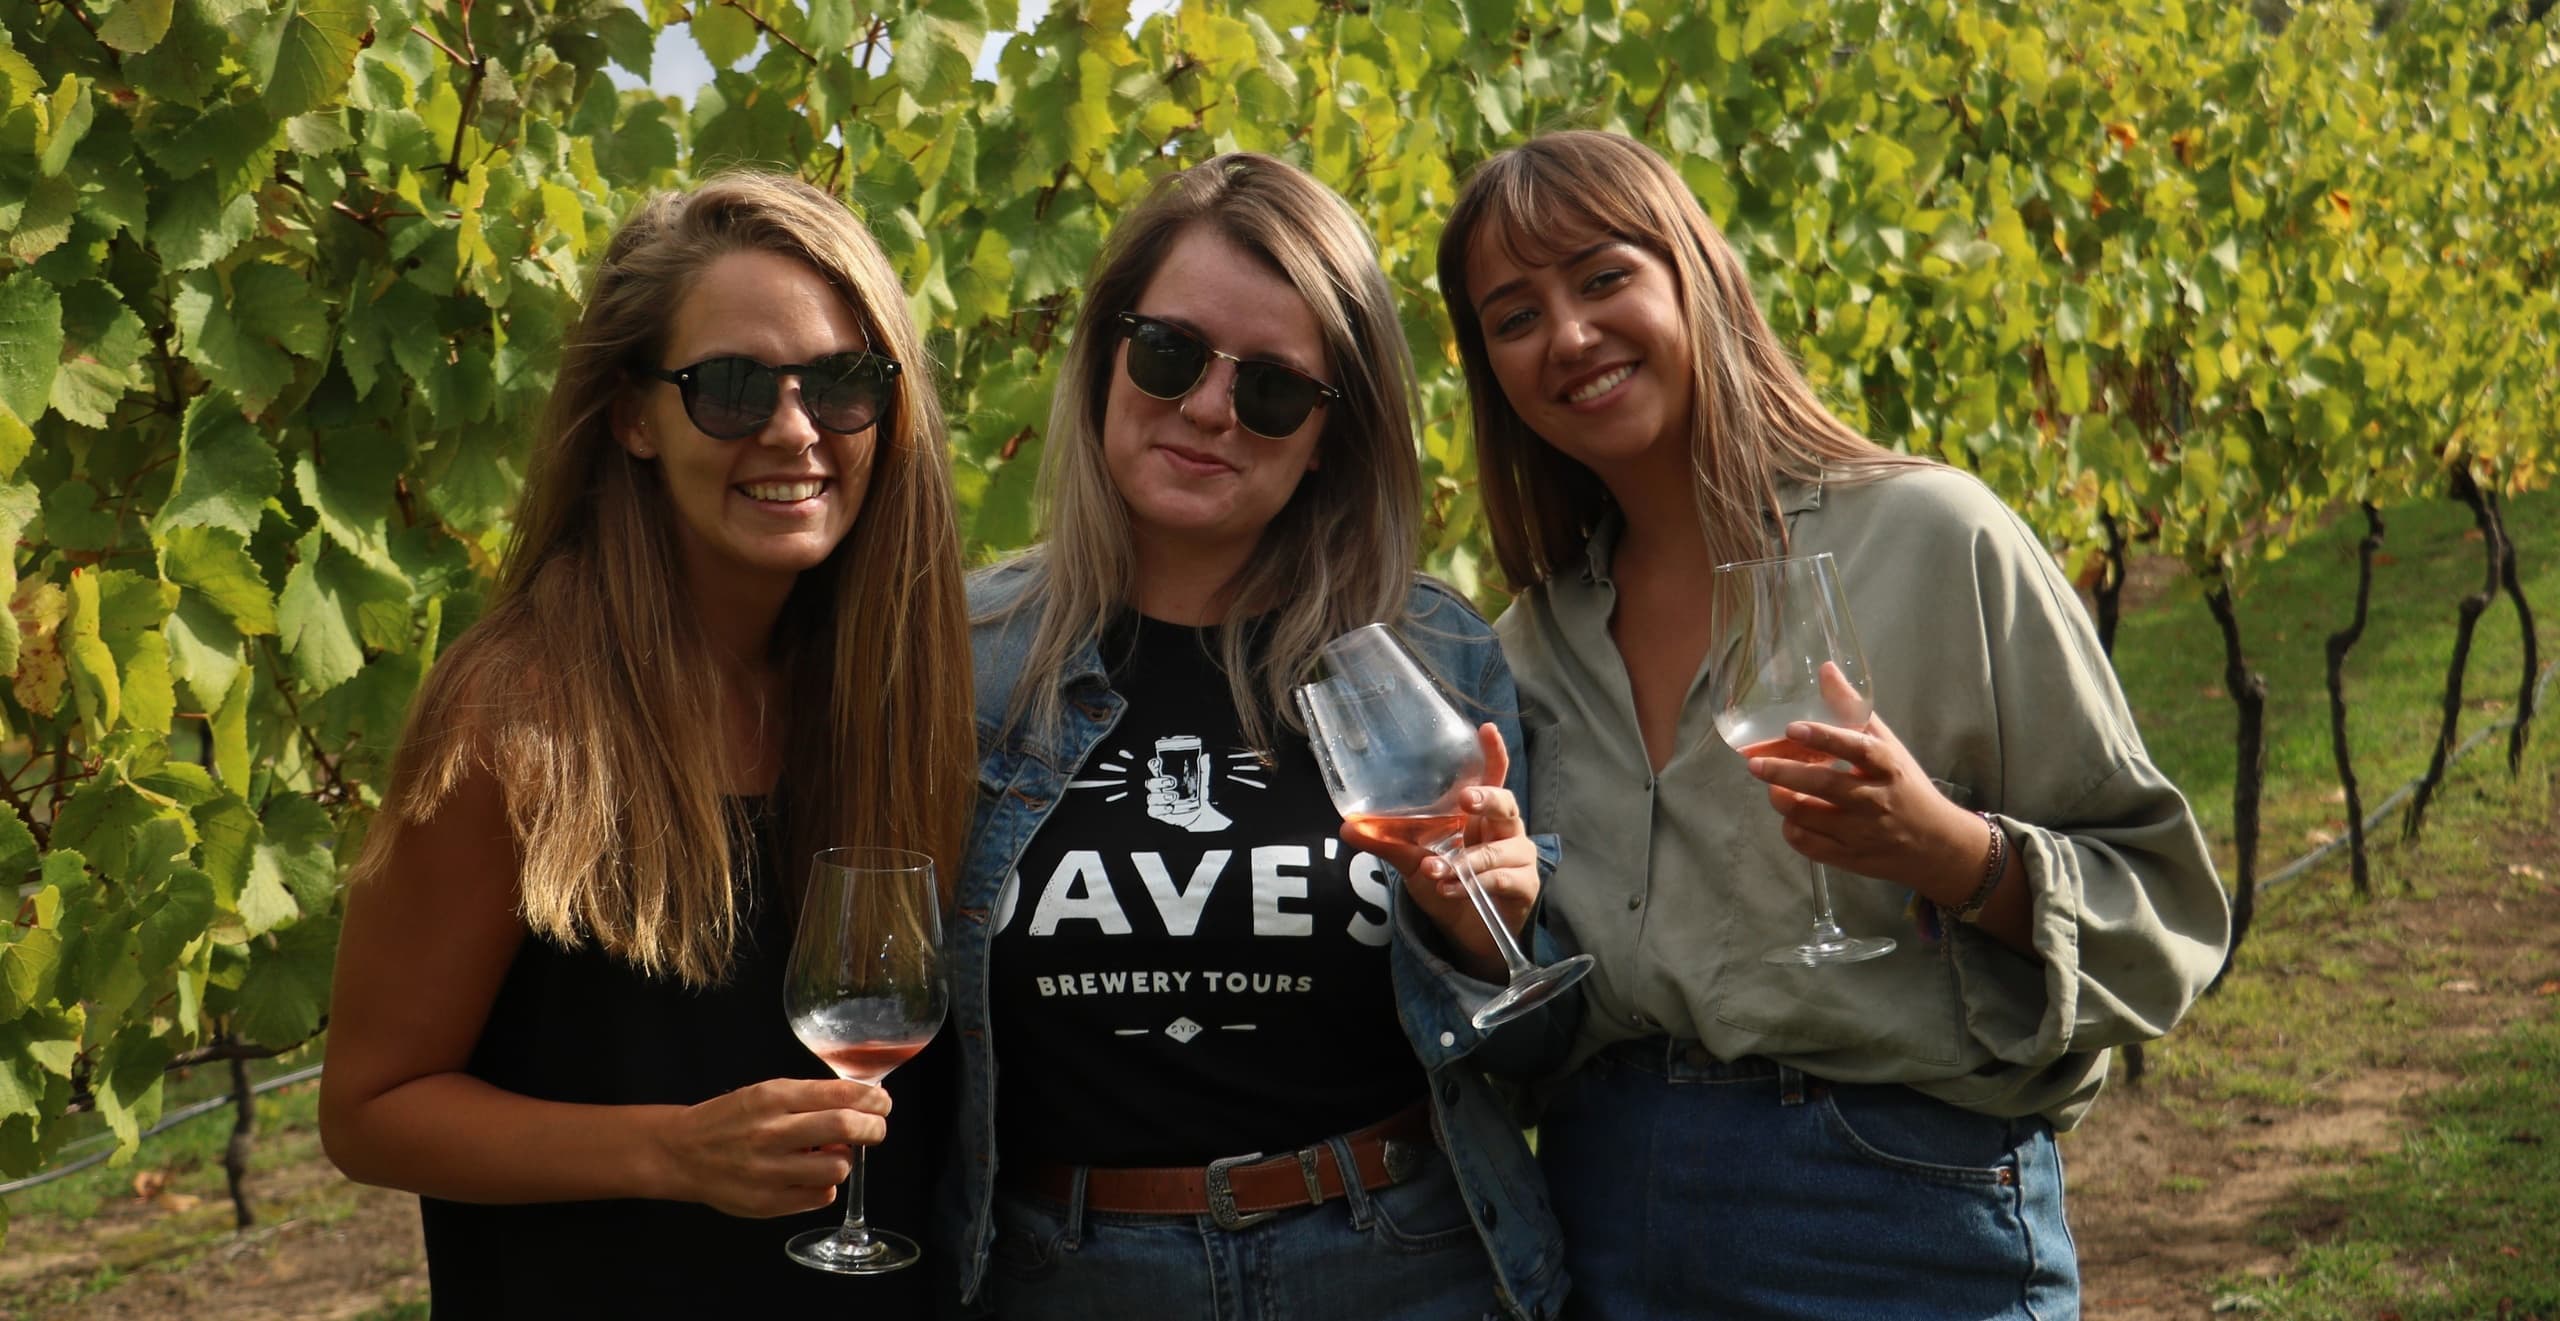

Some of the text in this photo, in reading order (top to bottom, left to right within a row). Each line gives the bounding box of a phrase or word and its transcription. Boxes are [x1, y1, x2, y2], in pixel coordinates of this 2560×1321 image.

[1036, 971, 1313, 997] BREWERY TOURS
[1170, 1024, 1197, 1034] SYD
